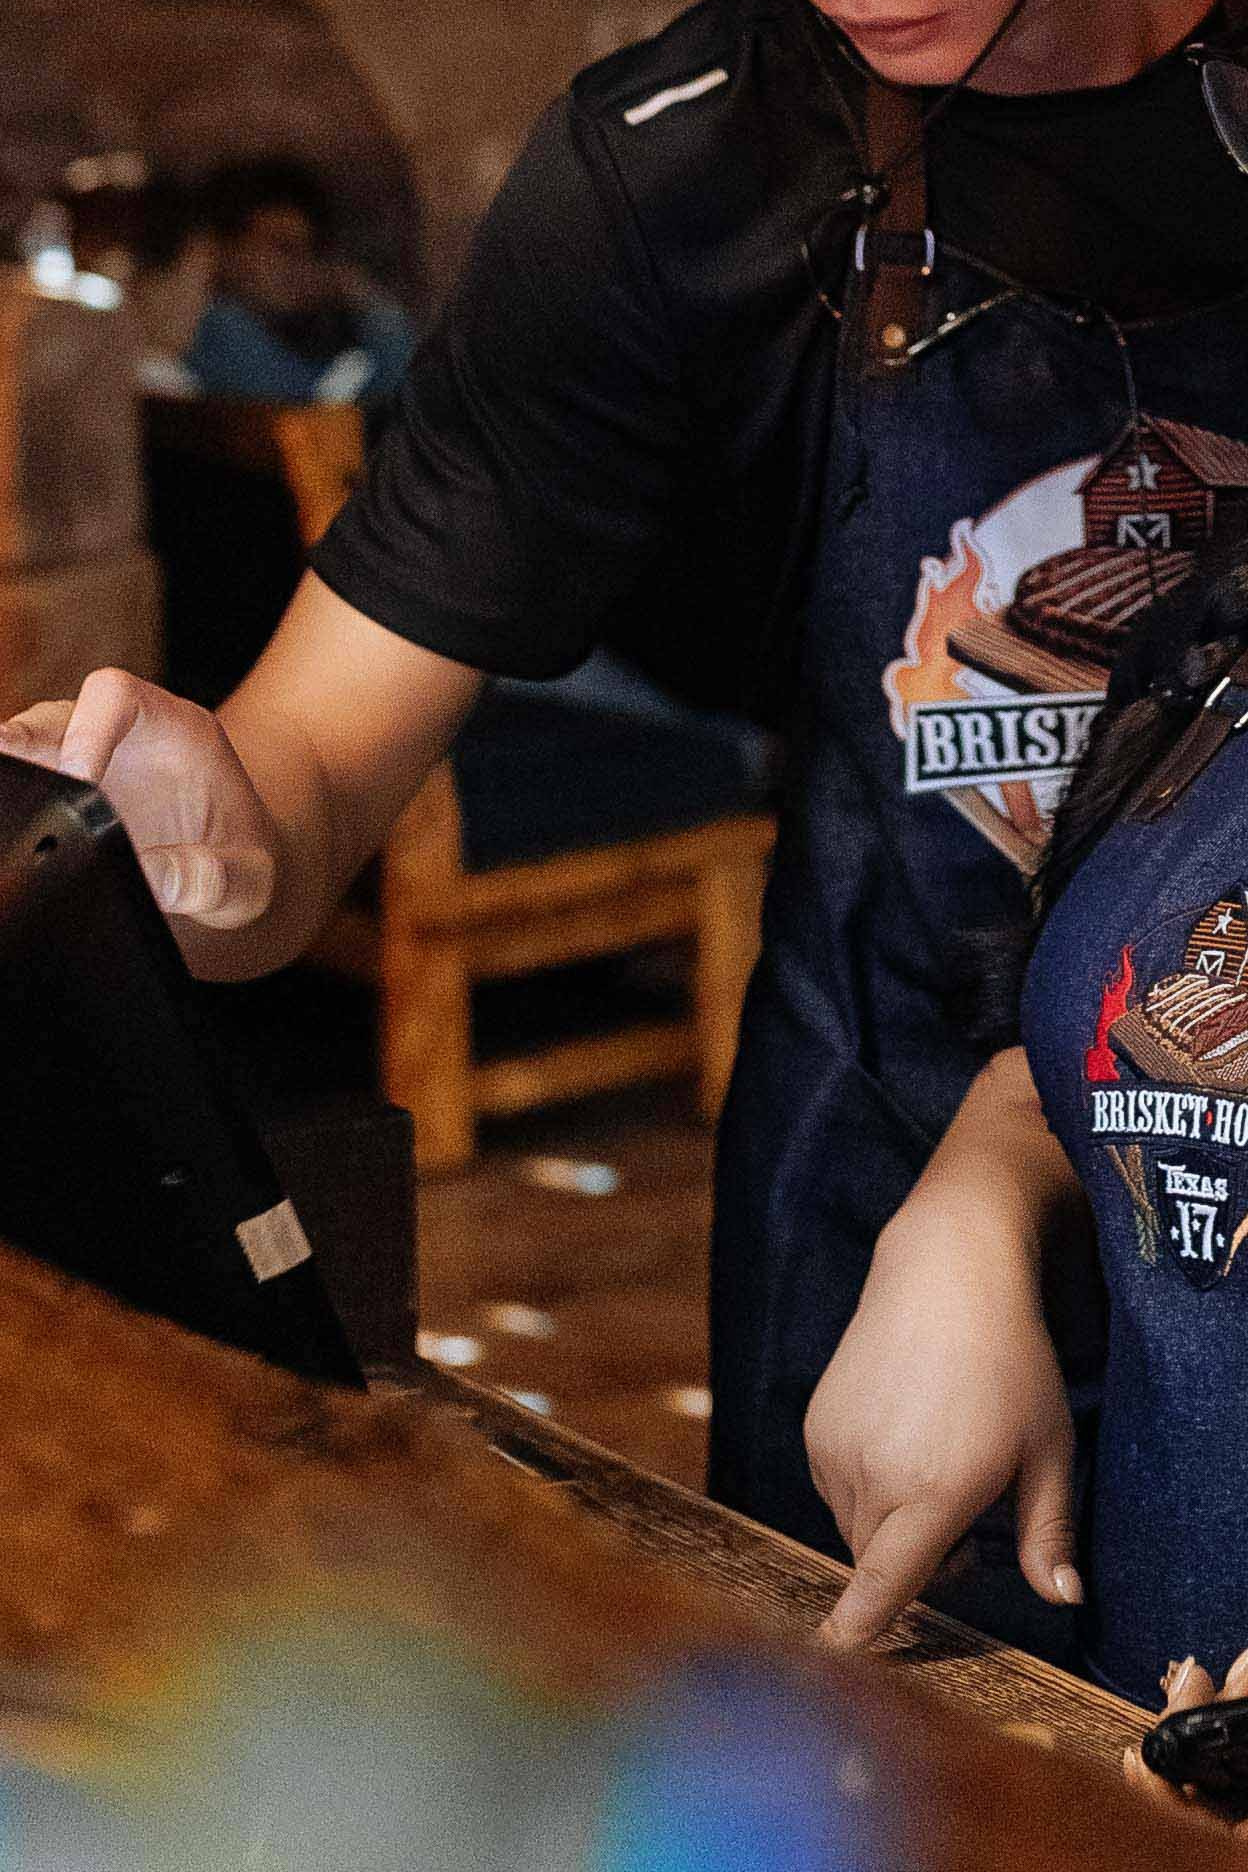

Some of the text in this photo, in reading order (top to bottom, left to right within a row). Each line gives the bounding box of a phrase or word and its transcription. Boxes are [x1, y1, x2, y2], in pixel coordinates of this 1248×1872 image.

[1091, 1089, 1208, 1138] BRISKET
[1157, 1160, 1228, 1200] TEXAS
[1175, 1199, 1216, 1262] 17
